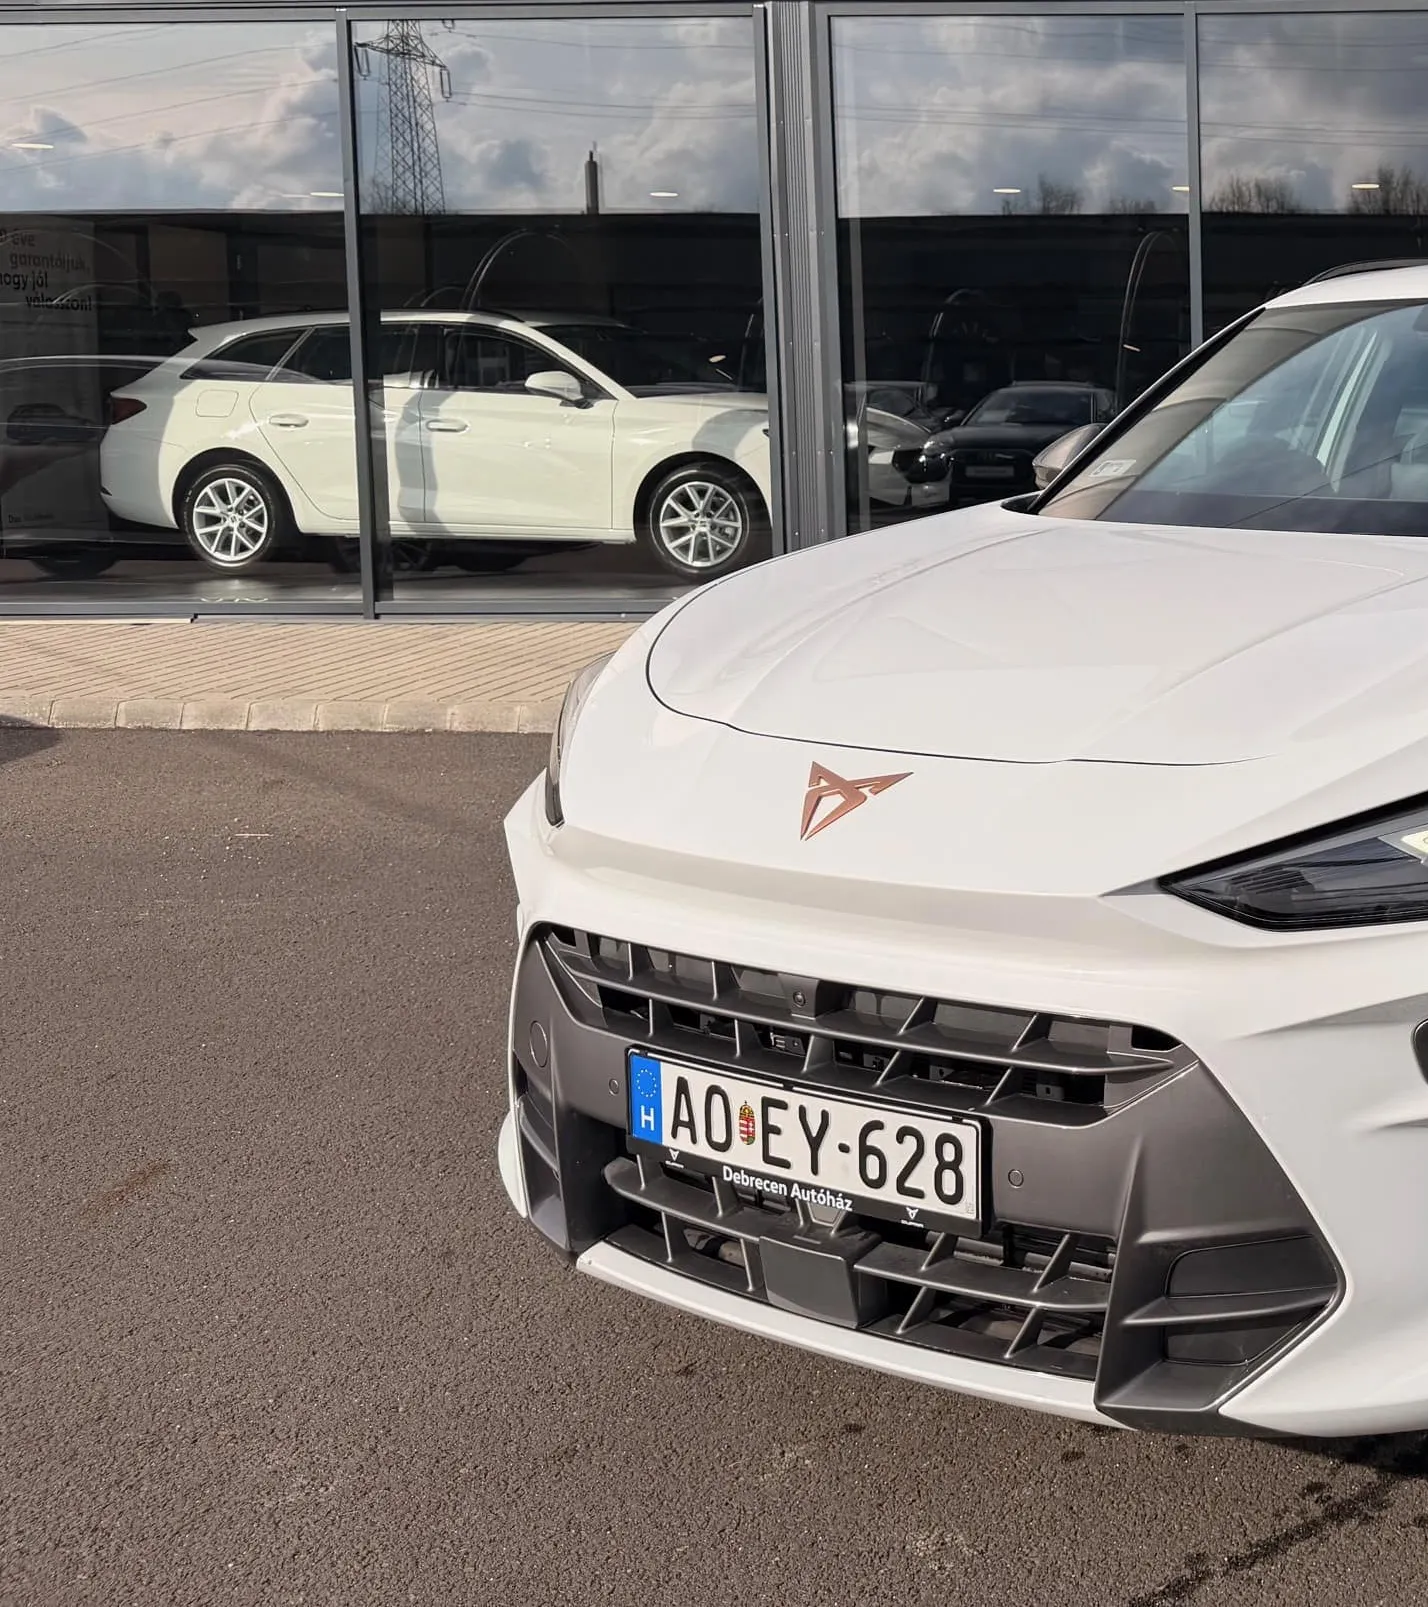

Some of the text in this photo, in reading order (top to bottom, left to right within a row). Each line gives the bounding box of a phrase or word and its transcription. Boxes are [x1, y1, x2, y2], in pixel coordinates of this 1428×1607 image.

[641, 1105, 655, 1131] H
[722, 1165, 853, 1212] Debrecen Autóház
